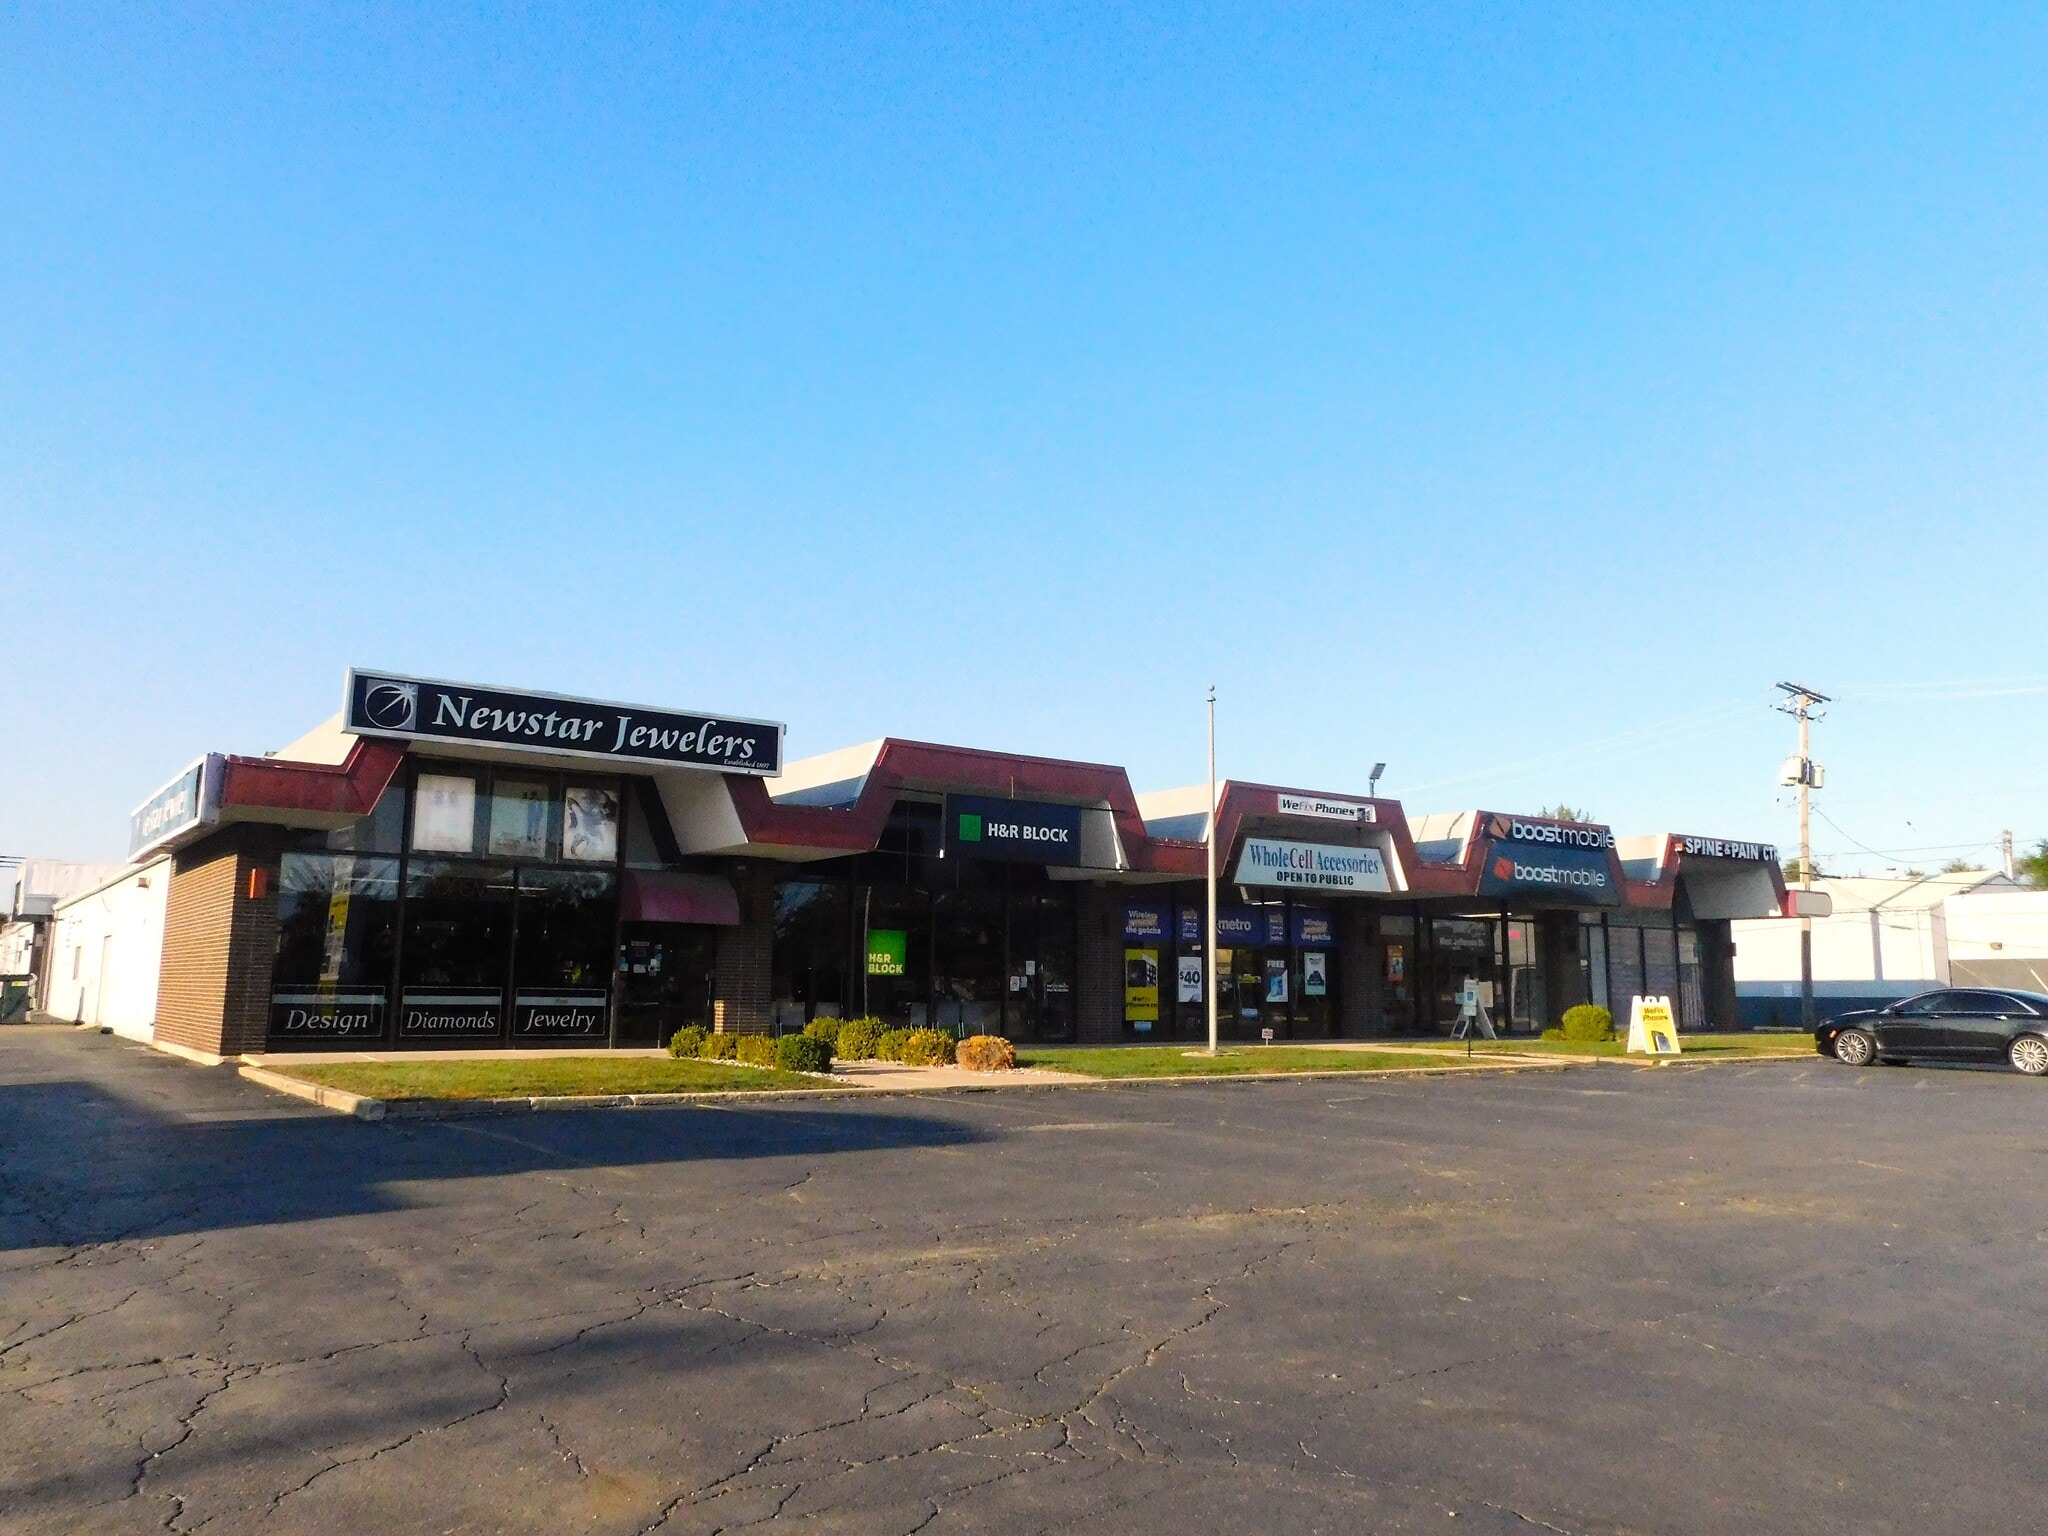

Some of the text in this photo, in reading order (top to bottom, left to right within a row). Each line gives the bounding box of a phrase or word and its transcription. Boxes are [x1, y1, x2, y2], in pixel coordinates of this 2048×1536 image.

[431, 693, 756, 759] Newstar Jewelers
[723, 758, 757, 768] Established
[987, 822, 1069, 843] H&R BLOCK
[1685, 837, 1724, 857] SPINE
[1731, 842, 1760, 861] PAIN
[1316, 850, 1379, 875] Accessories
[1276, 870, 1354, 886] OPEN TO PUBLIC
[1218, 918, 1252, 931] metro
[868, 953, 891, 963] H&R
[1267, 960, 1285, 968] FREE
[868, 963, 903, 974] BLOCK
[1179, 970, 1201, 984] $40
[285, 1009, 368, 1035] Design
[406, 1011, 496, 1029] Diamonds
[524, 1009, 596, 1033] Jewelry
